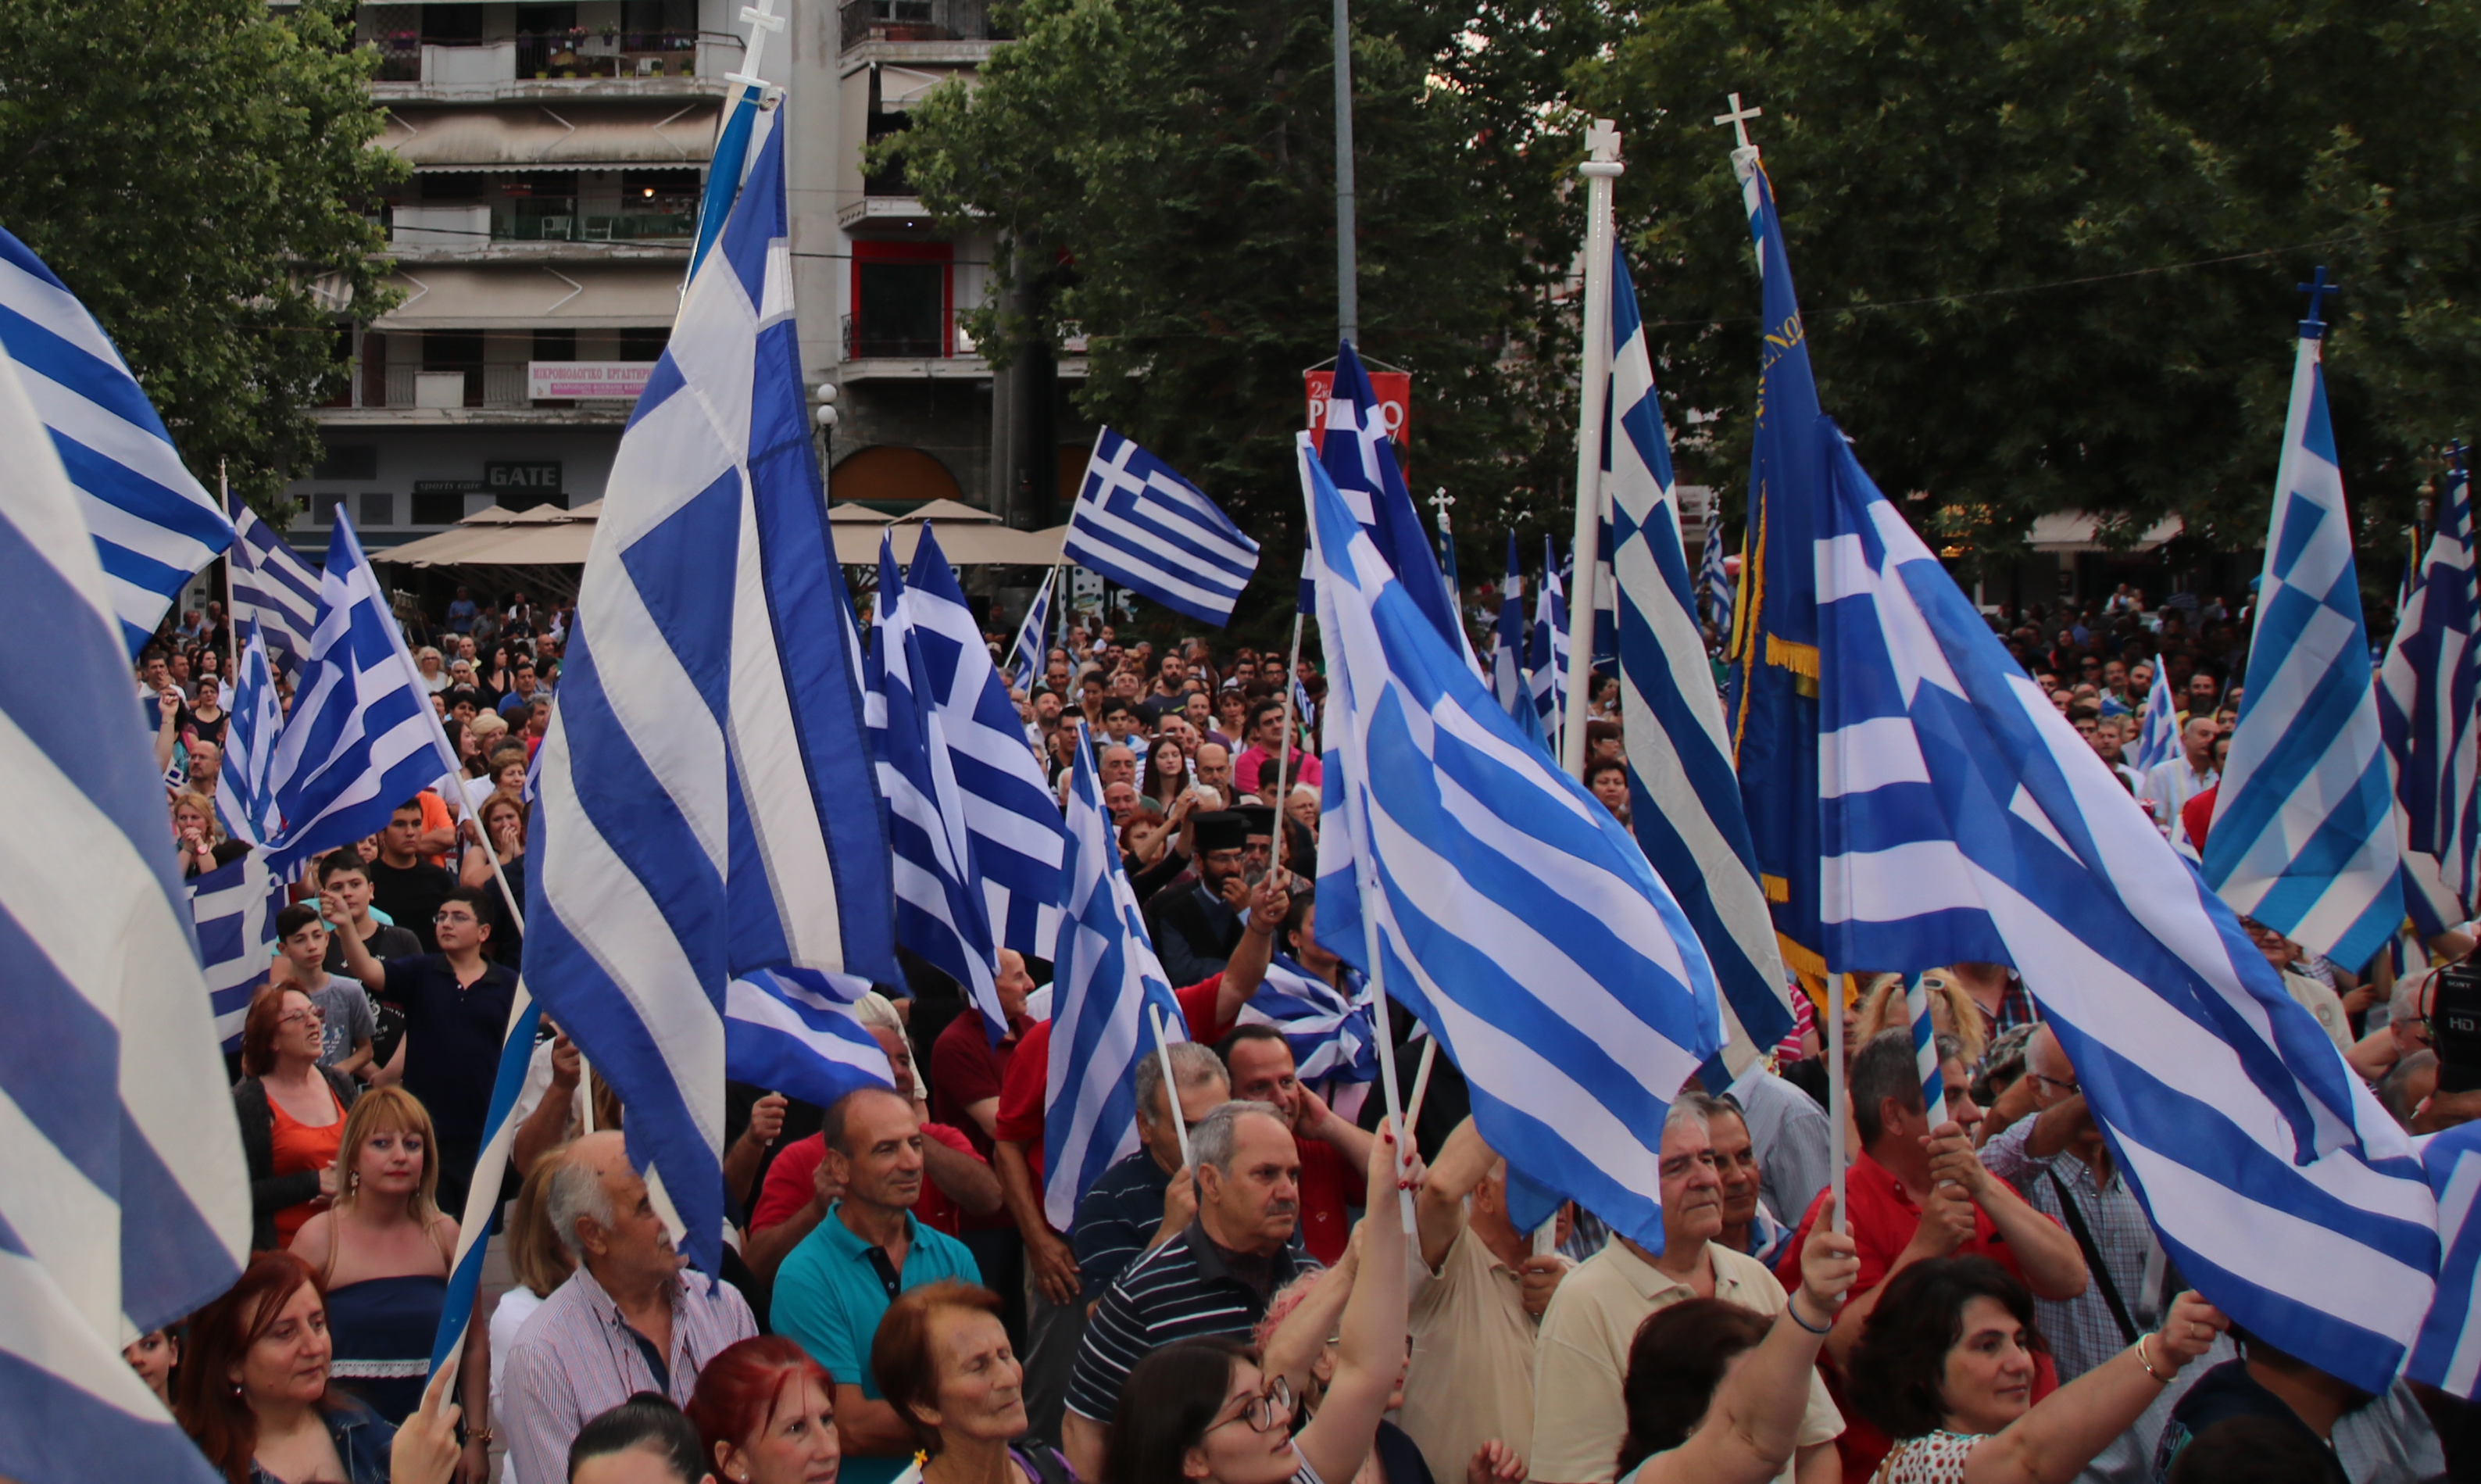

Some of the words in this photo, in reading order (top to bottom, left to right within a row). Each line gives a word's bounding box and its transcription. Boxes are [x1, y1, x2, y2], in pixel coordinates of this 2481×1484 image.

[533, 367, 602, 380] ΜΙΚΡΟΒΙΟΛΟΓΙΚΟ
[607, 367, 655, 380] ΕΡΓΑΣΤΗΡΙ
[490, 467, 556, 486] GATE
[420, 481, 454, 491] sports
[457, 481, 482, 490] cafe
[2447, 980, 2472, 989] SONY
[2449, 1017, 2475, 1032] HD
